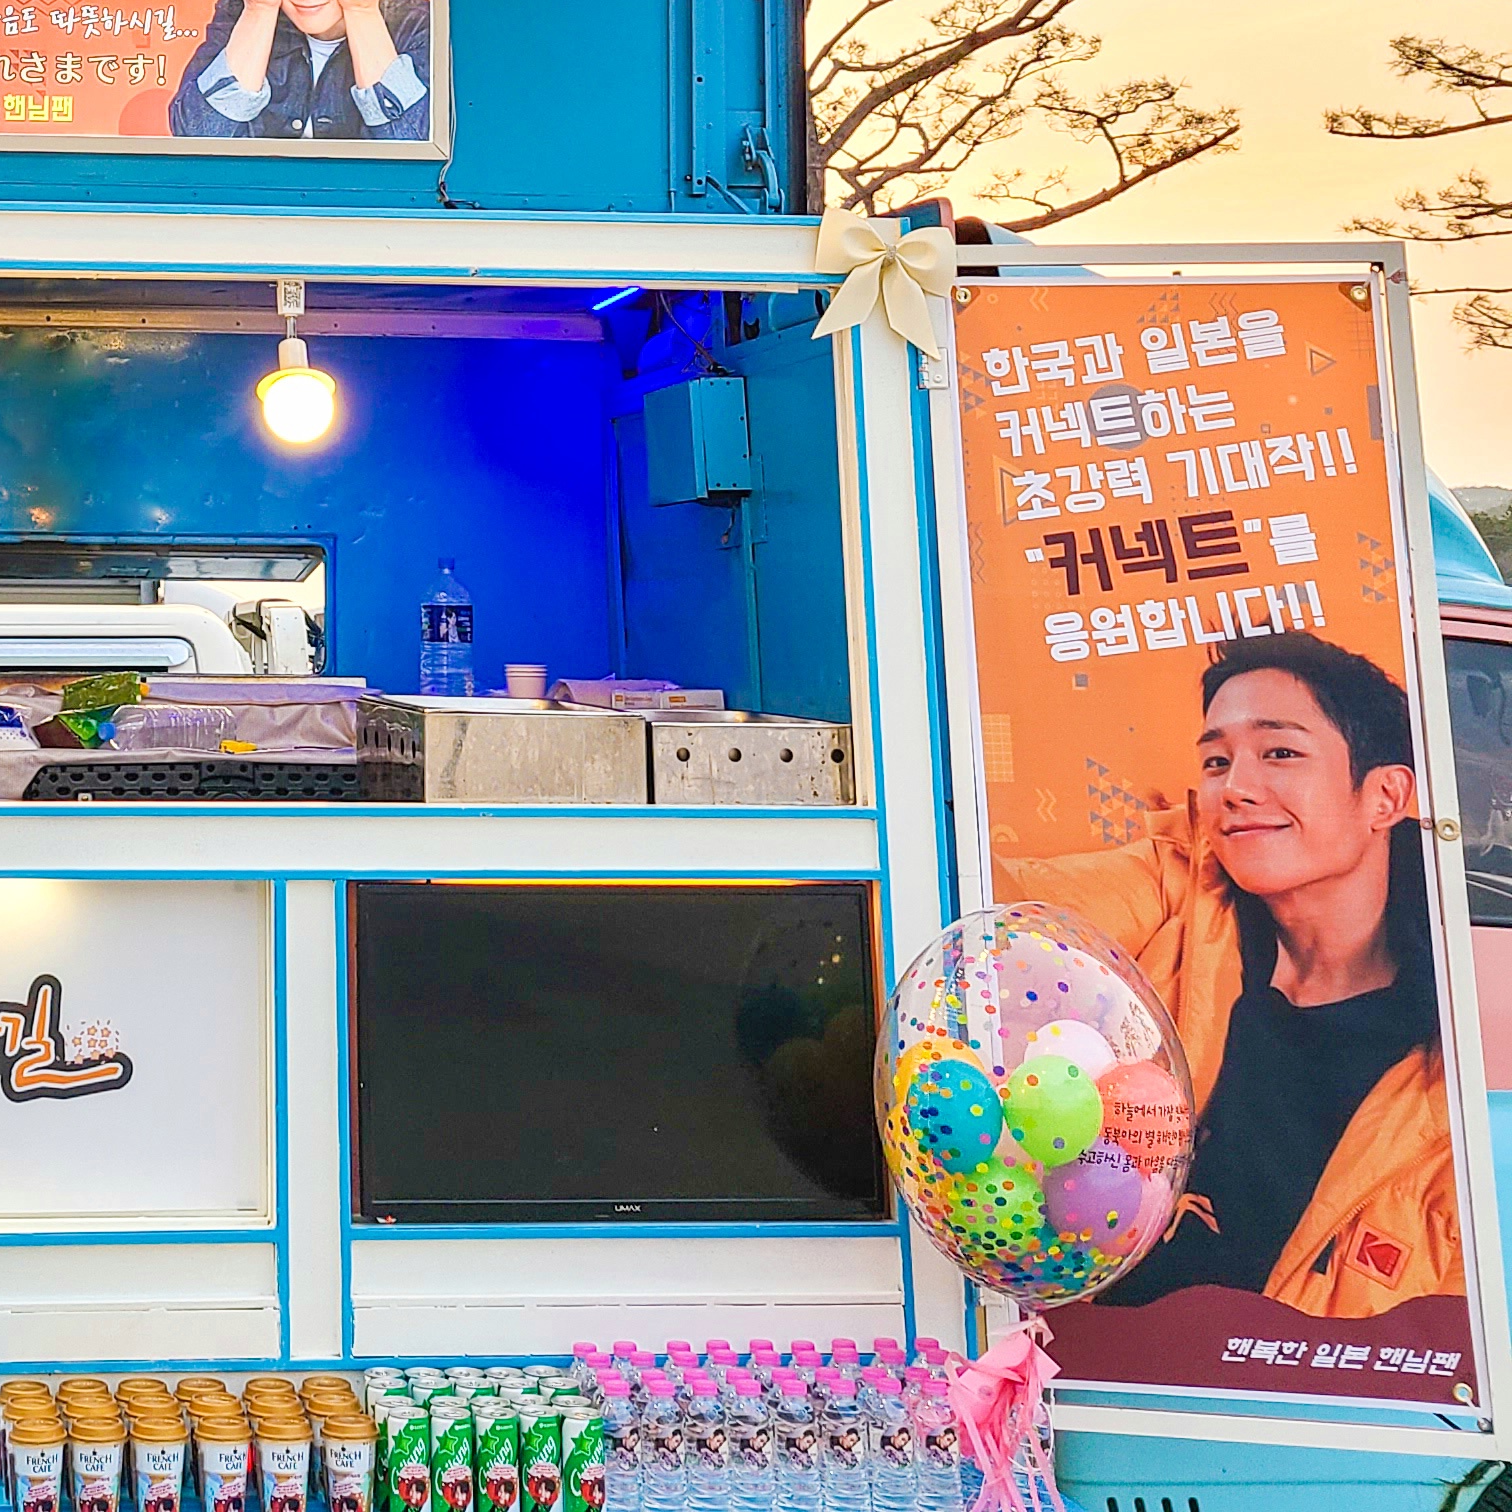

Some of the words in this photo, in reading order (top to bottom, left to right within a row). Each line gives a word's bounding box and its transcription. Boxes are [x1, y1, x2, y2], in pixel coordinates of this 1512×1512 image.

[49, 4, 200, 41] 따뜻하시길...
[3, 95, 74, 123] 핸님팬
[982, 333, 1124, 397] 한국과
[1140, 309, 1287, 375] 일본을
[994, 385, 1236, 458] 커넥트하는
[1012, 456, 1154, 521] 초강력
[1166, 427, 1359, 498] 기대작!!
[1044, 580, 1327, 662] 응원합니다!!
[1310, 1343, 1372, 1370] 일본
[1373, 1346, 1462, 1377] 핸님팬
